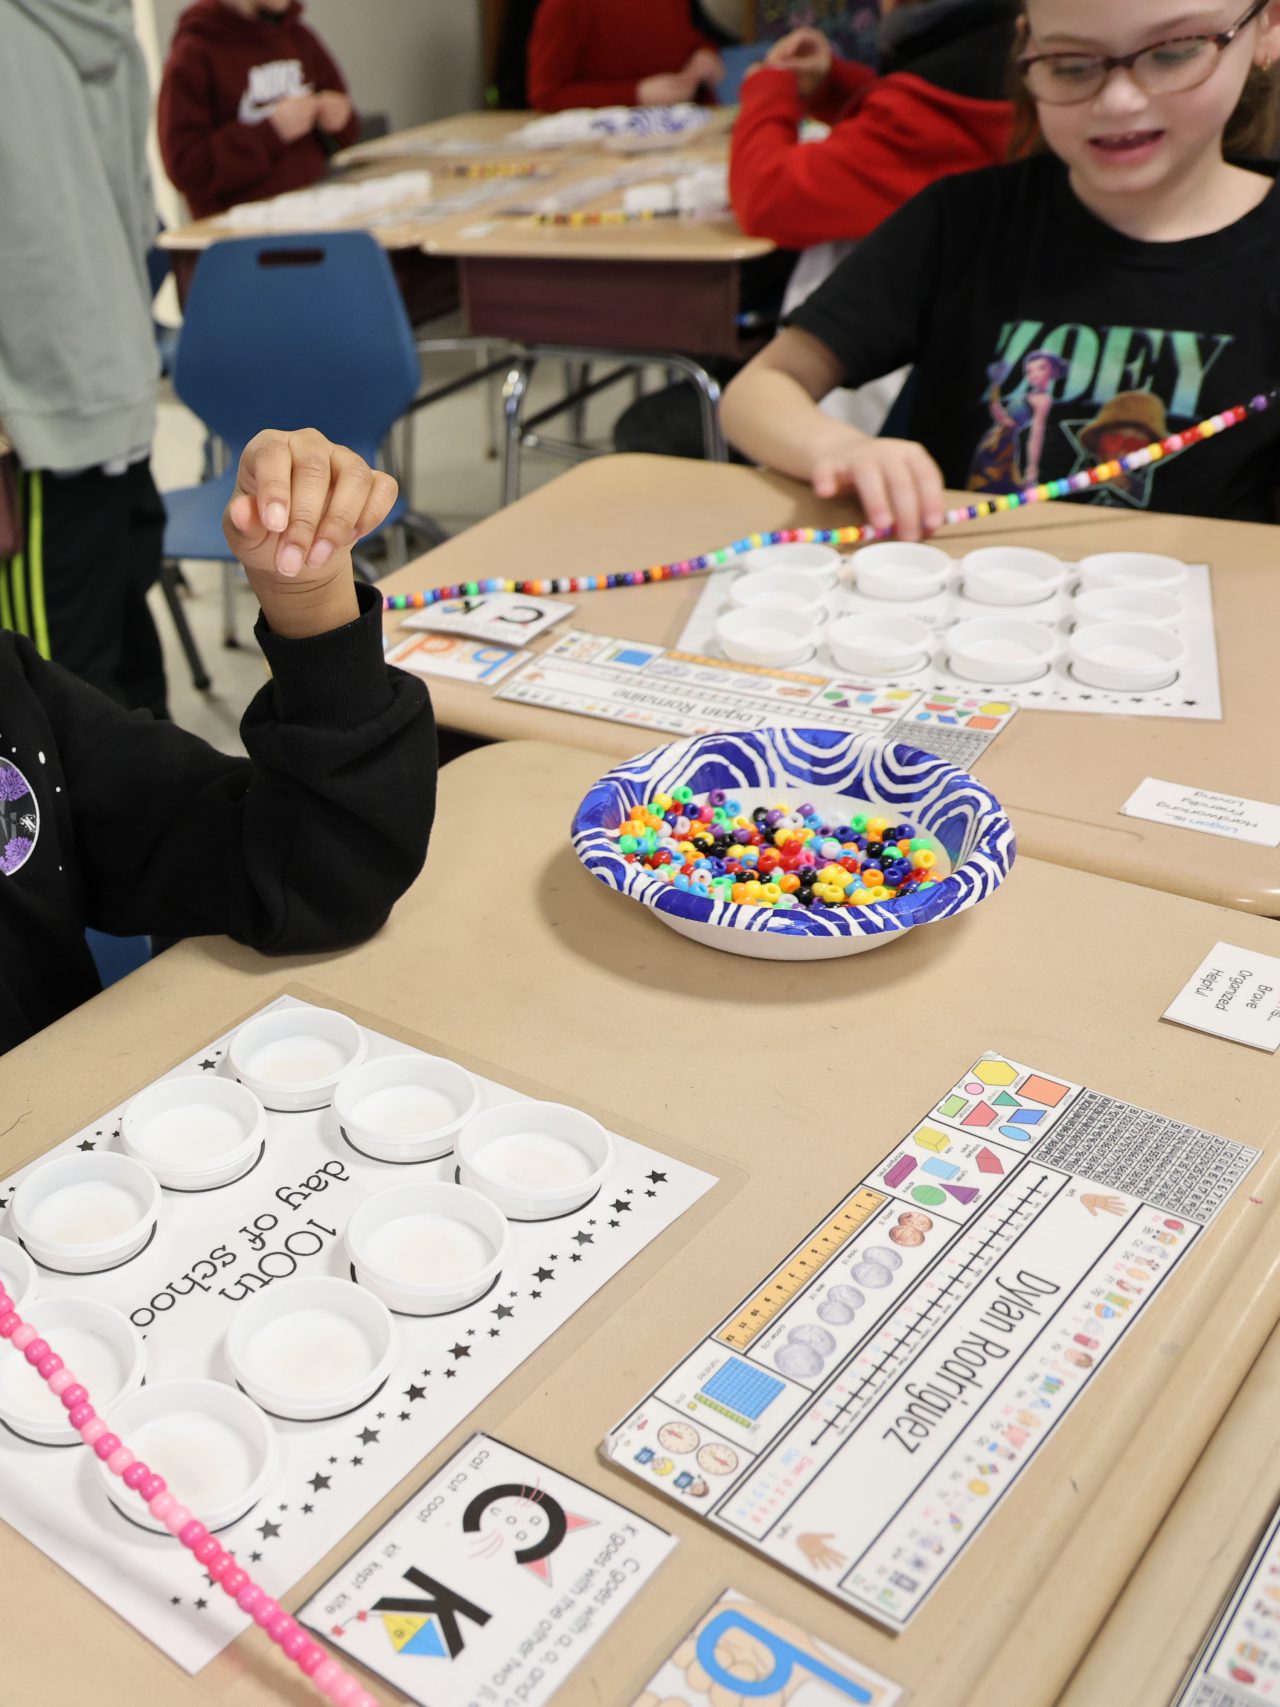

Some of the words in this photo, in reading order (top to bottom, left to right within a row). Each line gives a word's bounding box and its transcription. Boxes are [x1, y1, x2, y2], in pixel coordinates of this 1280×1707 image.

[980, 320, 1235, 418] ZOEY
[613, 689, 700, 713] Romaine
[703, 704, 767, 728] Logan
[1182, 797, 1245, 816] Friendly
[1194, 791, 1244, 807] Loving
[1156, 801, 1259, 828] Hardworking
[1188, 819, 1238, 833] Logan
[1195, 968, 1225, 998] Helpful
[1214, 969, 1253, 1012] Organized
[1246, 984, 1273, 1009] Brave
[275, 1160, 350, 1211] day
[239, 1214, 278, 1251] of
[130, 1245, 237, 1338] schoo
[980, 1270, 1061, 1333] Dylan
[882, 1331, 1011, 1454] Rodriguez
[469, 1450, 490, 1471] cat
[447, 1472, 468, 1493] cut
[417, 1495, 445, 1523] coat
[463, 1483, 567, 1564] C
[621, 1524, 638, 1537] K
[382, 1543, 402, 1559] kit
[352, 1561, 383, 1590] kept
[623, 1558, 640, 1573] C
[324, 1592, 351, 1616] kite
[370, 1566, 493, 1661] K
